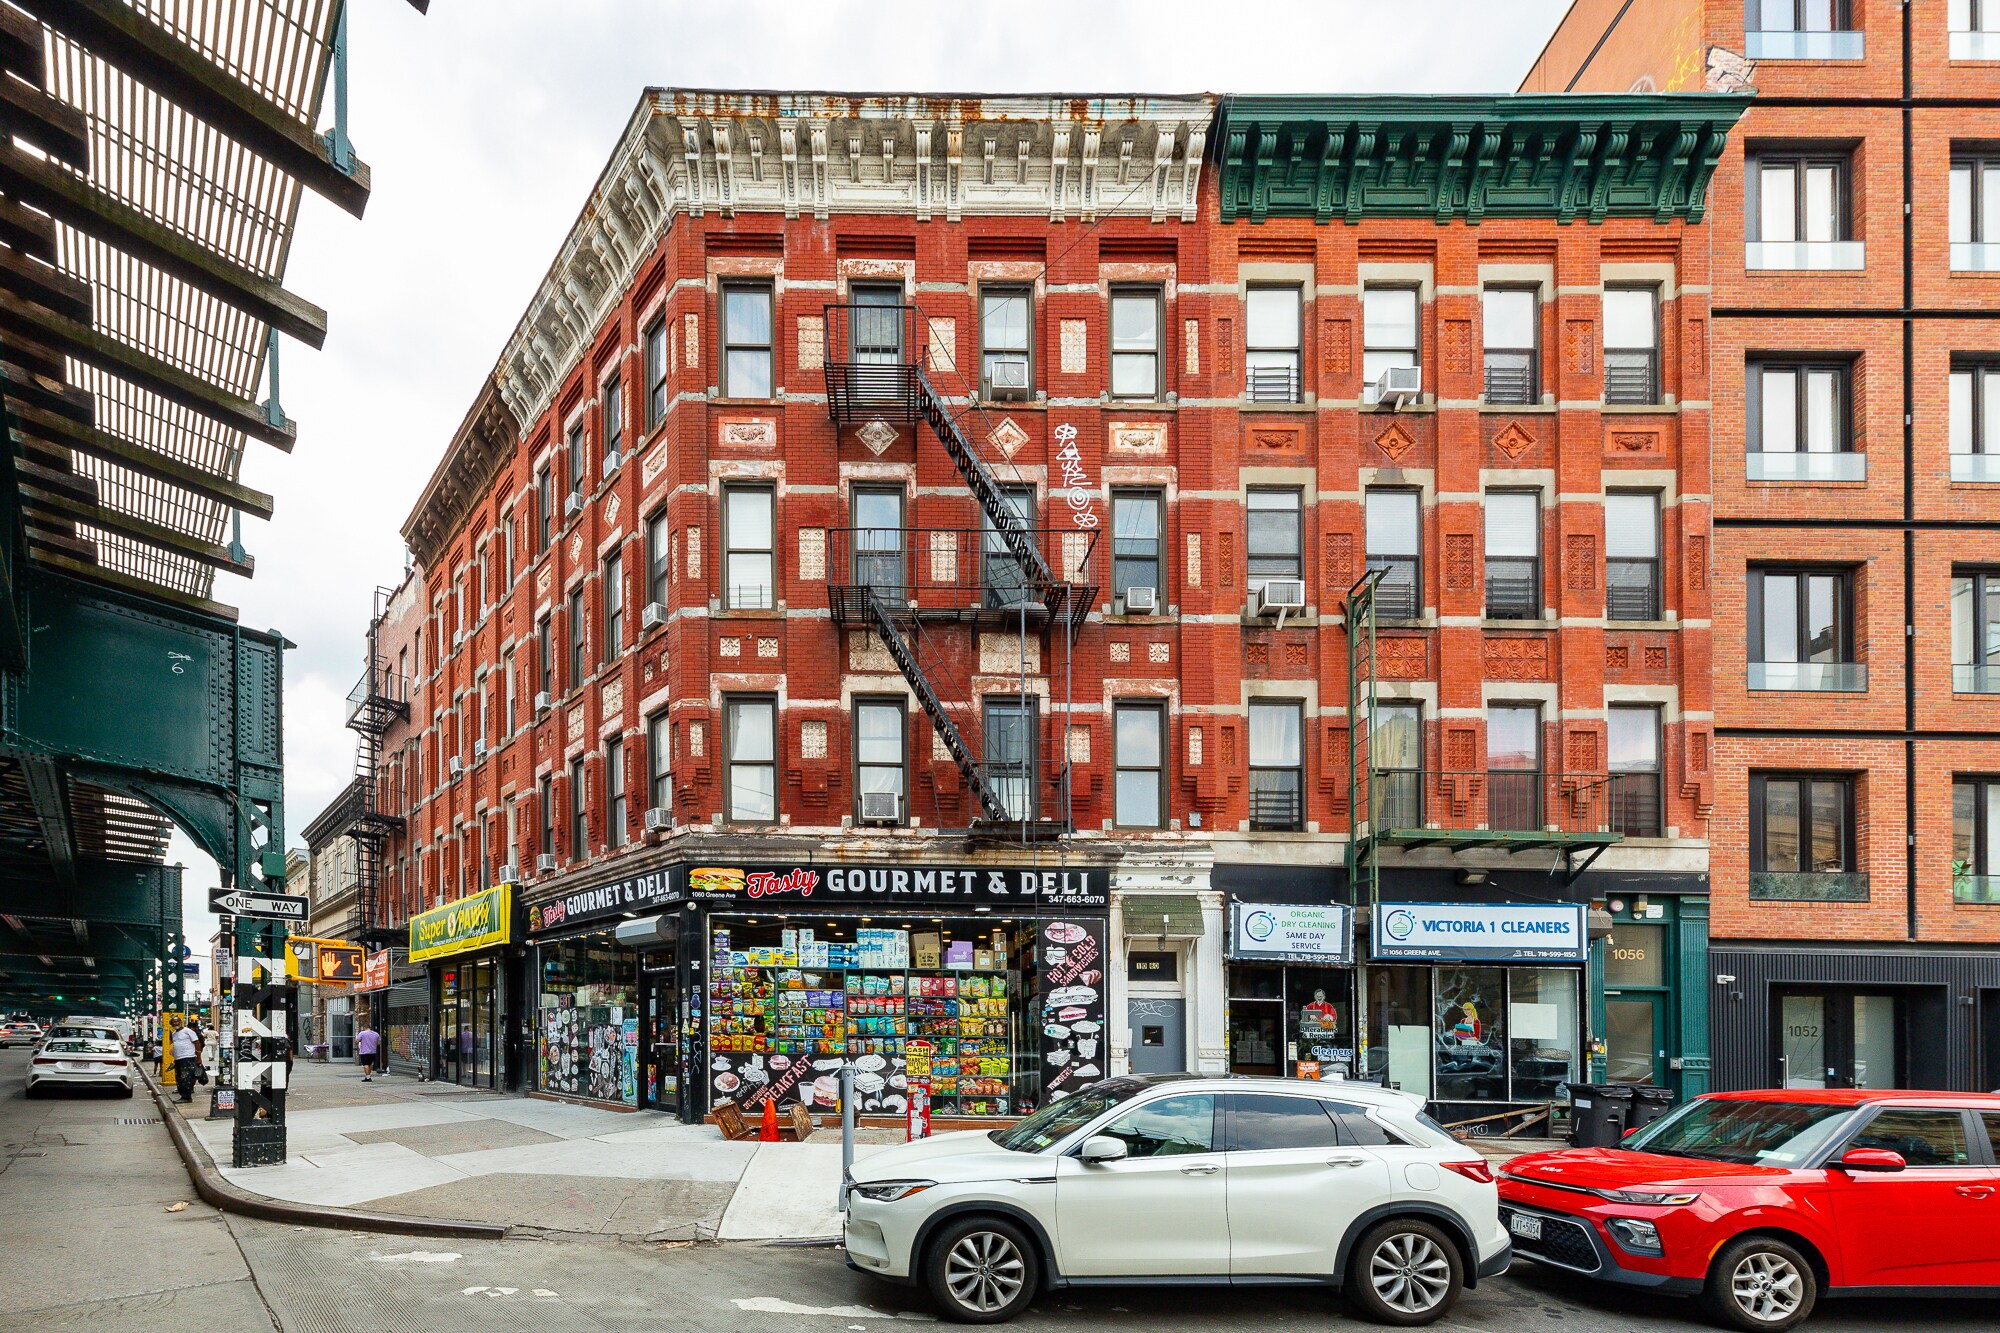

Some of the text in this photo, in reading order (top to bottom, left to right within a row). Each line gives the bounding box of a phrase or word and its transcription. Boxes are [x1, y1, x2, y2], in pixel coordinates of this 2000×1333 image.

[747, 867, 1089, 899] Tasty GOURMET & DELI
[543, 871, 670, 927] Tasty GOURMET & DELI
[652, 891, 680, 904] 347-663-6070
[705, 891, 725, 899] Greene
[1048, 895, 1105, 904] 347-663-6070
[226, 897, 298, 913] ONE WAY
[419, 918, 446, 945] Super
[1281, 920, 1336, 929] DRY CLEANING
[1422, 919, 1570, 934] VICTORIA 1 CLEANERS
[1285, 932, 1326, 940] SAME DAY
[1291, 942, 1321, 950] SERVICE
[1046, 963, 1066, 983] HOT
[1072, 934, 1096, 960] COLD
[1612, 949, 1645, 960] 1056
[350, 954, 362, 976] 5
[1060, 947, 1099, 987] SANDWICHES
[1789, 1025, 1818, 1037] 1052
[1311, 1045, 1353, 1056] Cleaners
[759, 1053, 812, 1107] BREAKFAST
[742, 1084, 769, 1110] DELICIOUS
